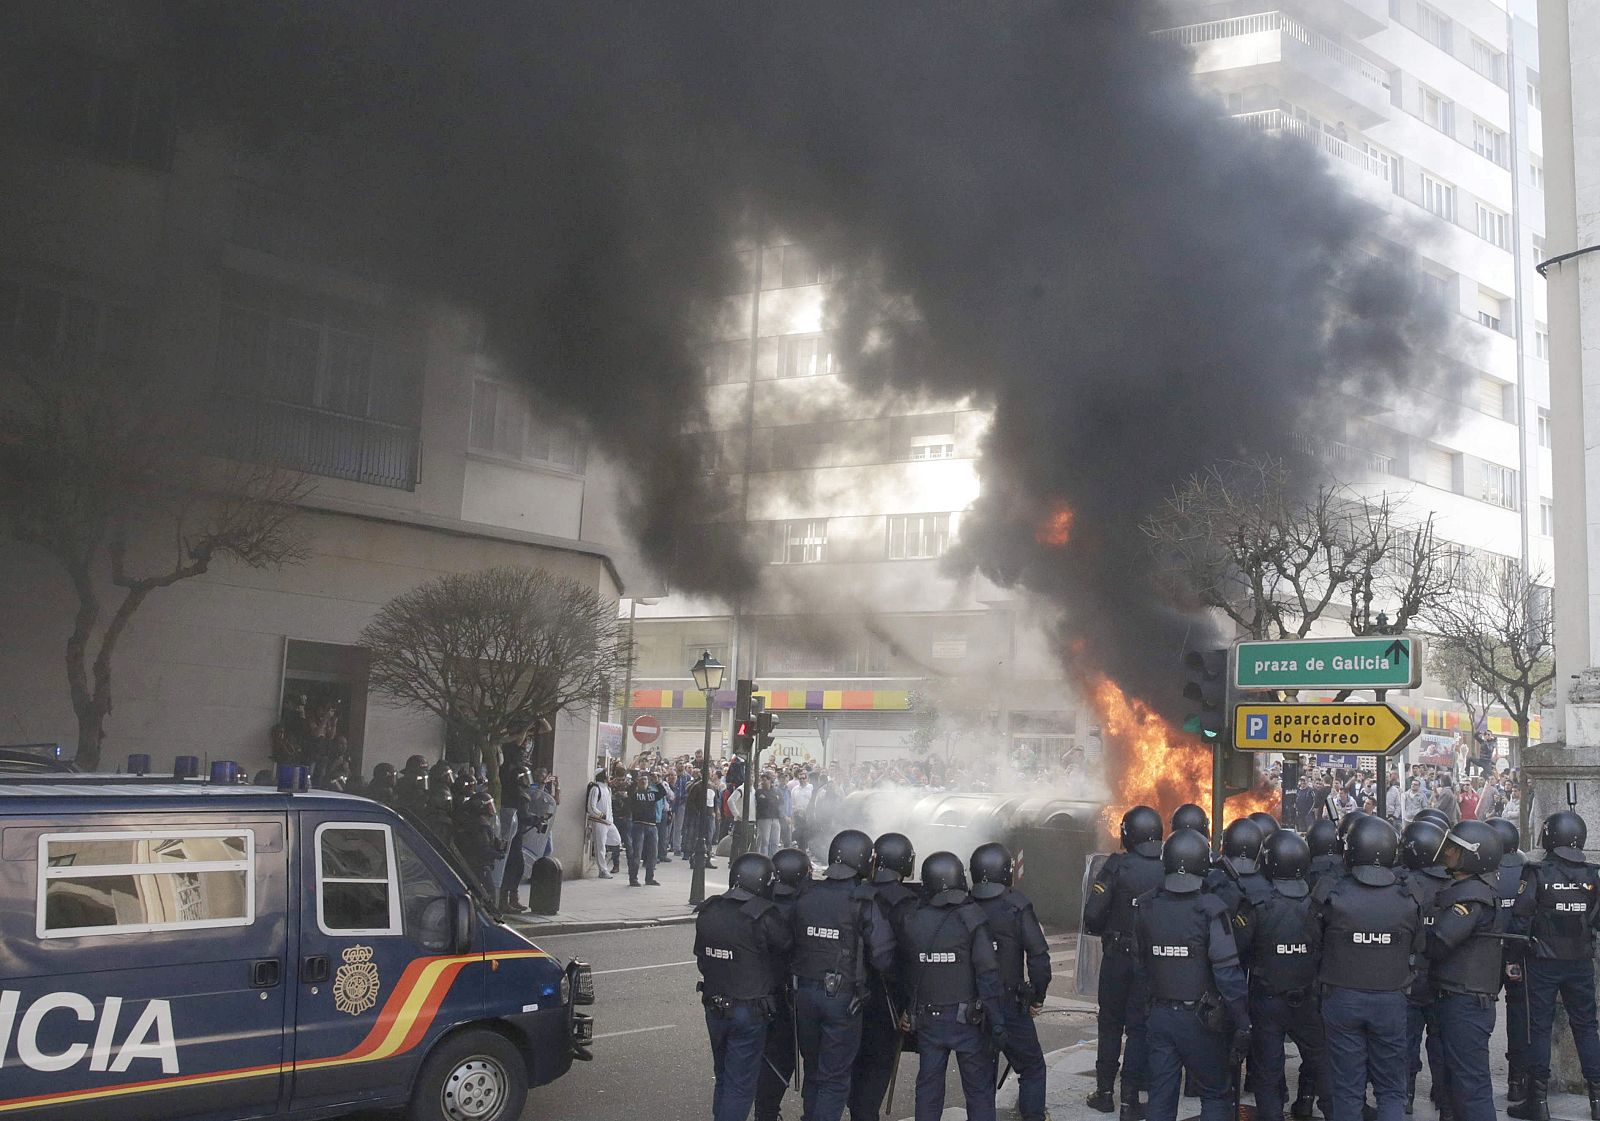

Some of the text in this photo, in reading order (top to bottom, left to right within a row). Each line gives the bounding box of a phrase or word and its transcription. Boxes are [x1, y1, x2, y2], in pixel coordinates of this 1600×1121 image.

[1254, 655, 1390, 675] praza de Galicia
[1250, 717, 1263, 737] P
[1274, 712, 1376, 728] aparcadoiro
[1273, 730, 1359, 744] do Hórreo
